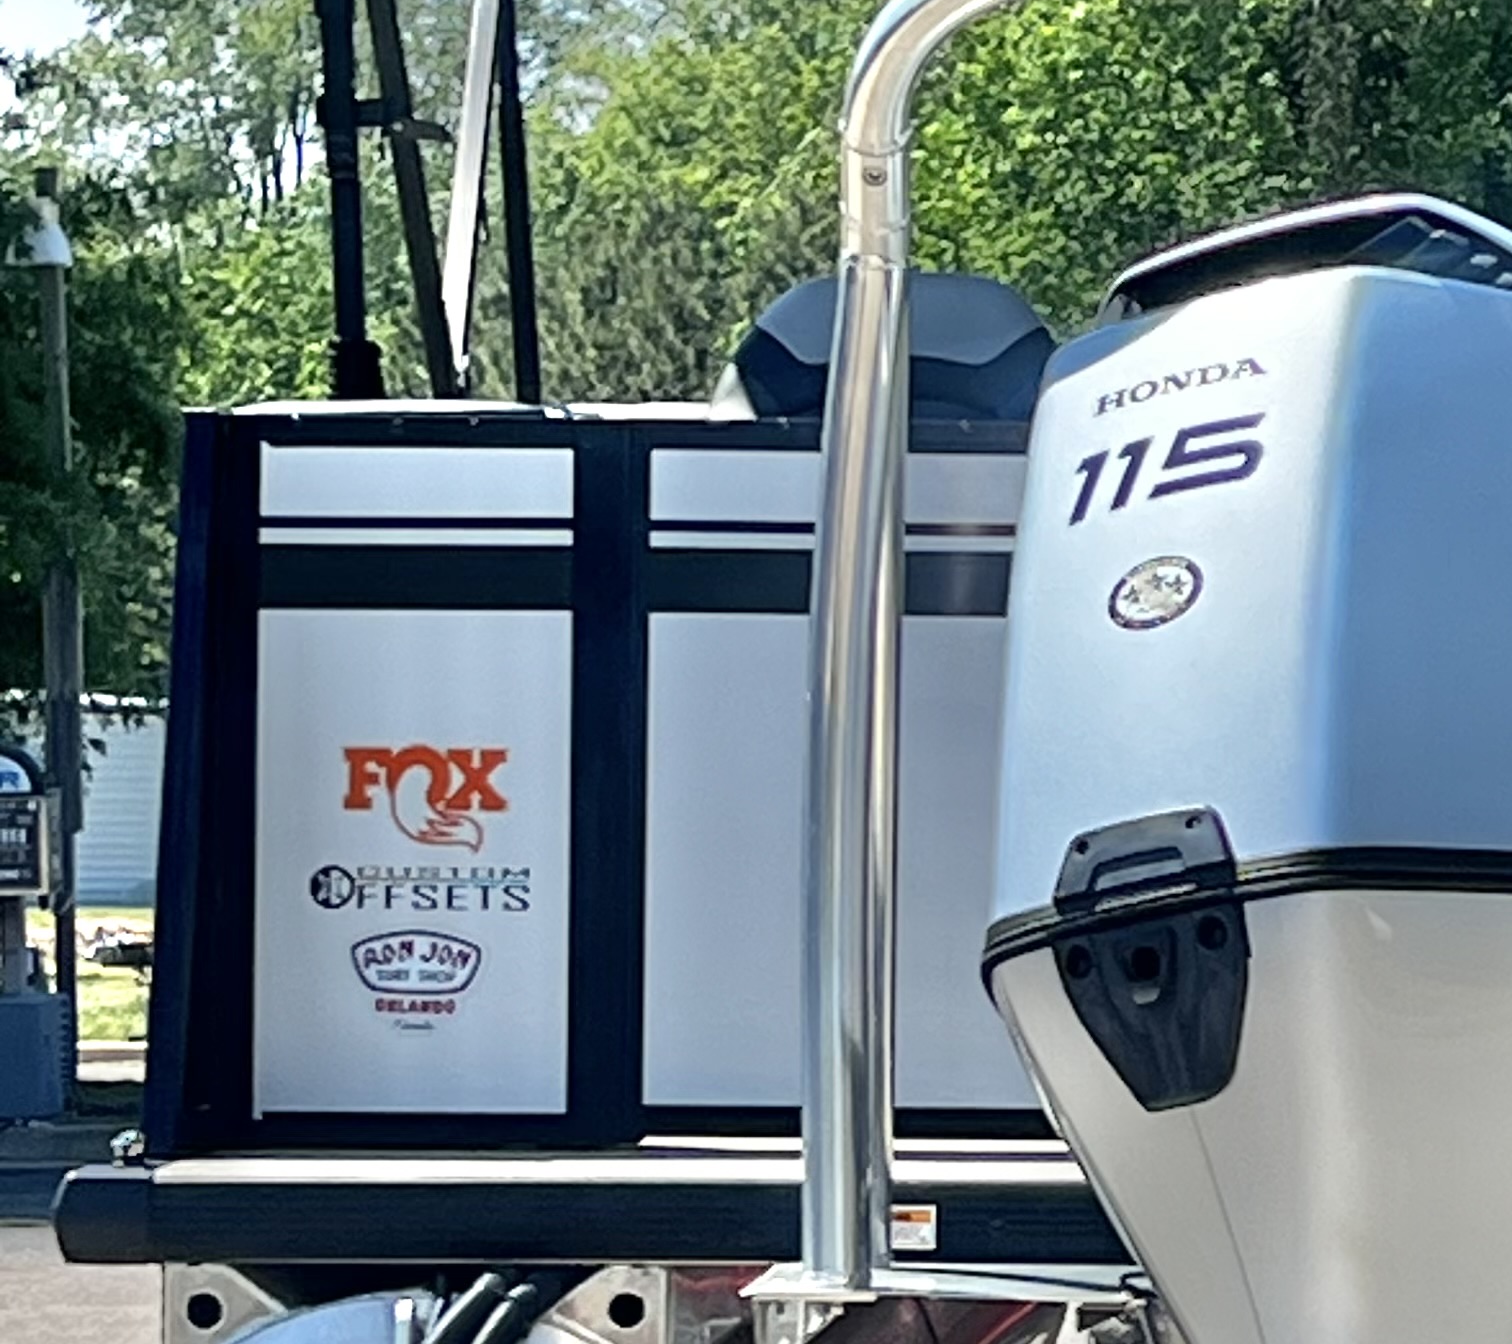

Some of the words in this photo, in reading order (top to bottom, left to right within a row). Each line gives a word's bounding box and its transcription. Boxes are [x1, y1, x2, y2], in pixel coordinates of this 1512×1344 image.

[1093, 357, 1267, 418] HONDA
[1068, 411, 1267, 526] 115
[342, 744, 509, 814] FOX
[362, 940, 415, 969] RON
[419, 942, 472, 970] JON
